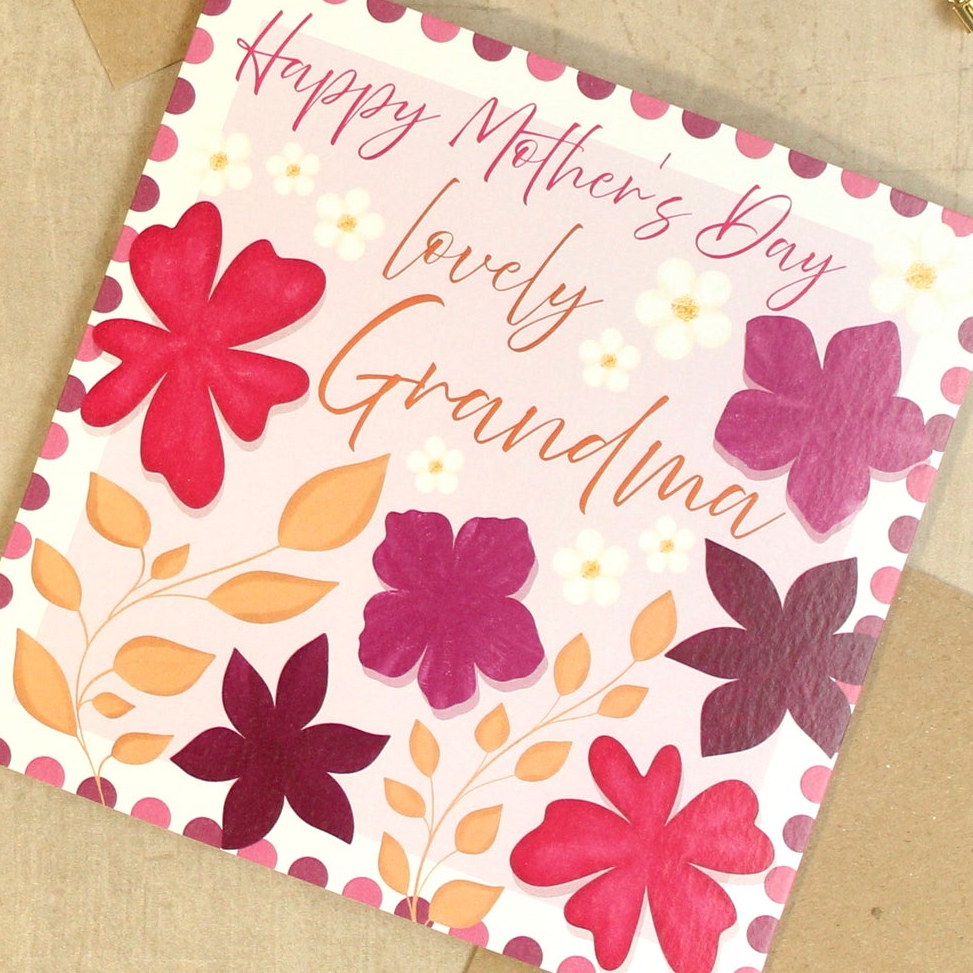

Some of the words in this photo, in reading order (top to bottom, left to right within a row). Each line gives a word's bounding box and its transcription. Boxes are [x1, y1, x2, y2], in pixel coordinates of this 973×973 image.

[235, 10, 441, 160] Happy
[449, 97, 692, 241] Mother's
[695, 184, 847, 311] Day
[382, 178, 604, 353] lovely
[317, 294, 787, 540] Grandma
